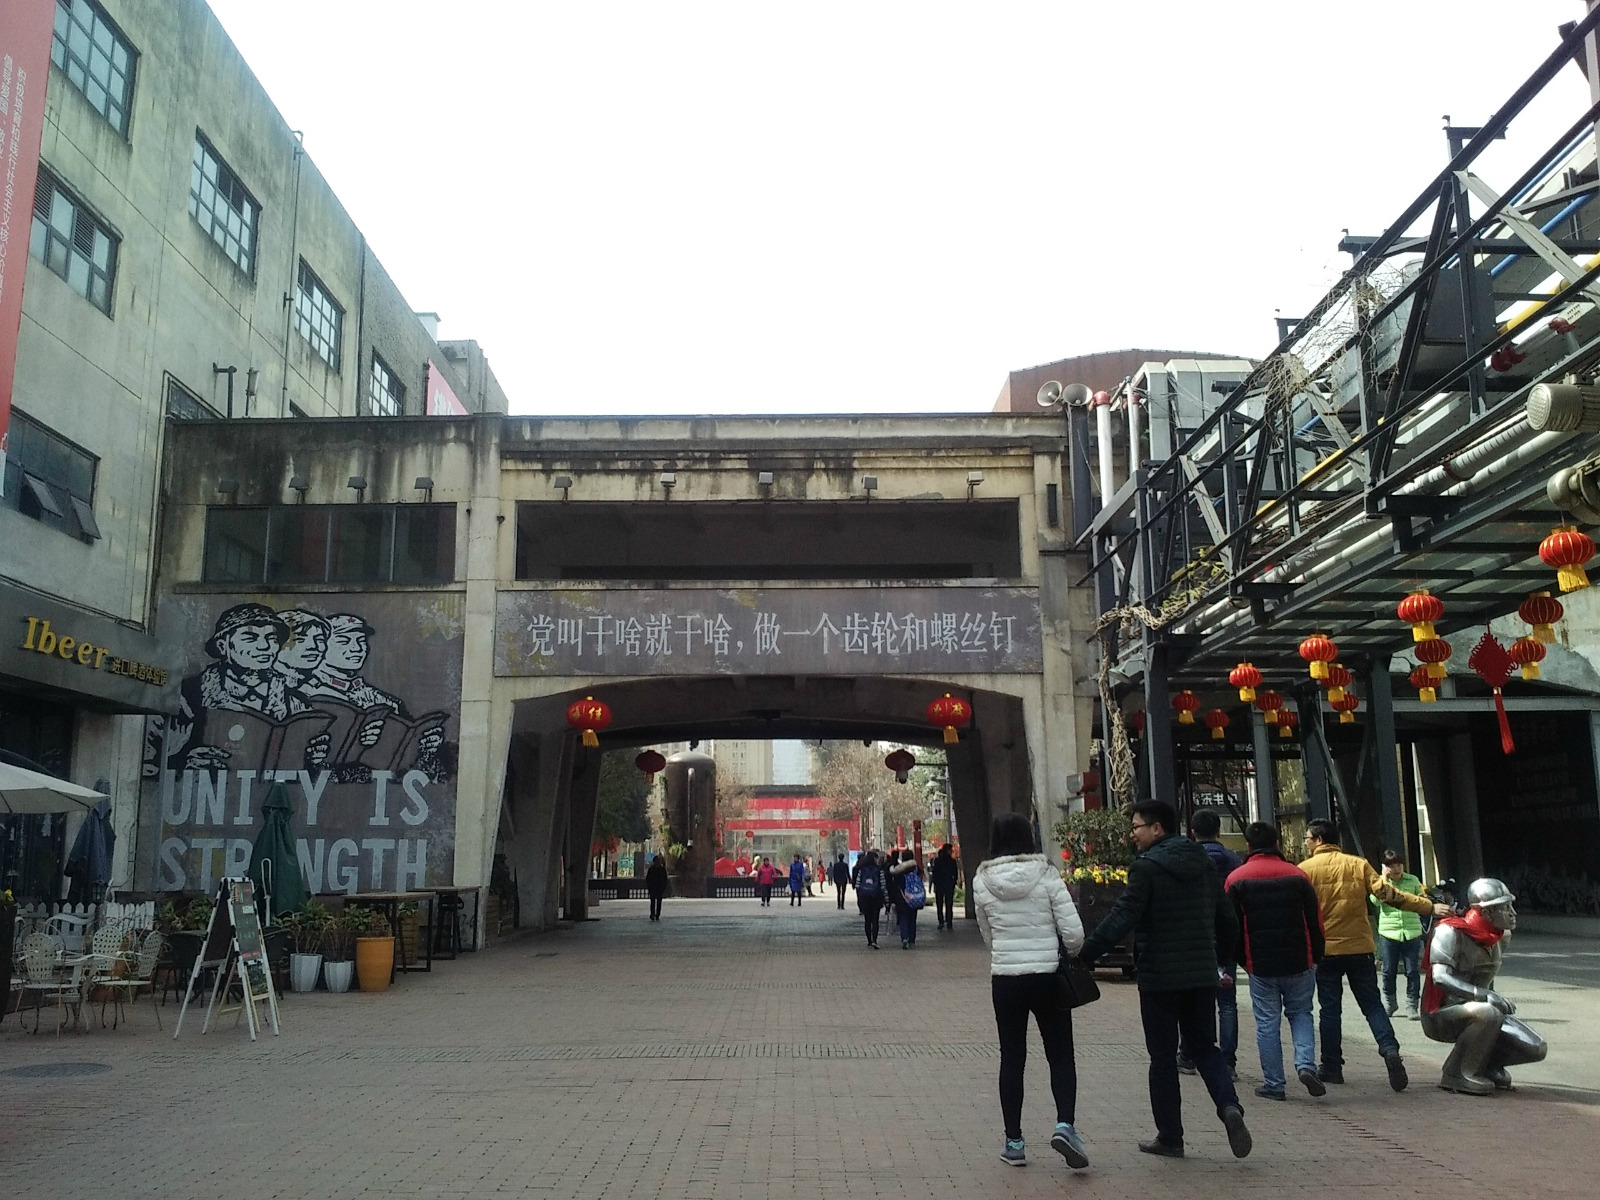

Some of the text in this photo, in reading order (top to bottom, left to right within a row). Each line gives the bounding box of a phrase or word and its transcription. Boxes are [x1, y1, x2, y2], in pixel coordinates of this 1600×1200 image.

[23, 616, 109, 669] Ibeer
[369, 769, 430, 825] IS
[159, 838, 428, 895] STRNGTH
